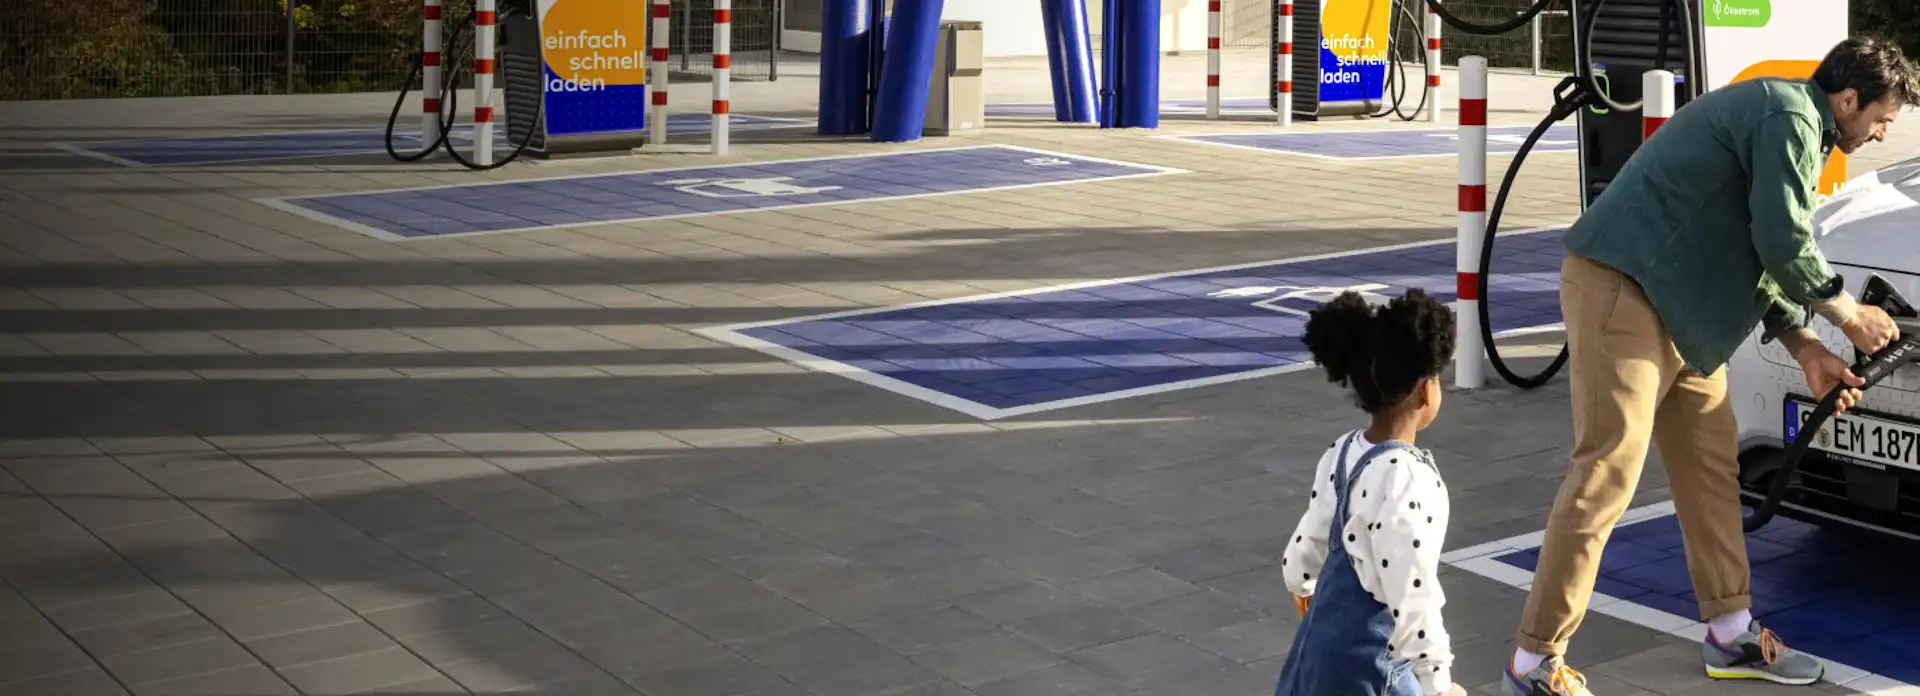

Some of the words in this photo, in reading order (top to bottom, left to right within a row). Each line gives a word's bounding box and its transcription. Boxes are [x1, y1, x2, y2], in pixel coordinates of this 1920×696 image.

[545, 29, 626, 49] einfach
[1321, 33, 1375, 49] einfach
[569, 50, 643, 70] schnell
[1336, 50, 1385, 66] schnell
[544, 72, 605, 92] laden
[1320, 68, 1360, 84] laden
[1834, 418, 1865, 454] EM
[1872, 426, 1920, 465] 187
